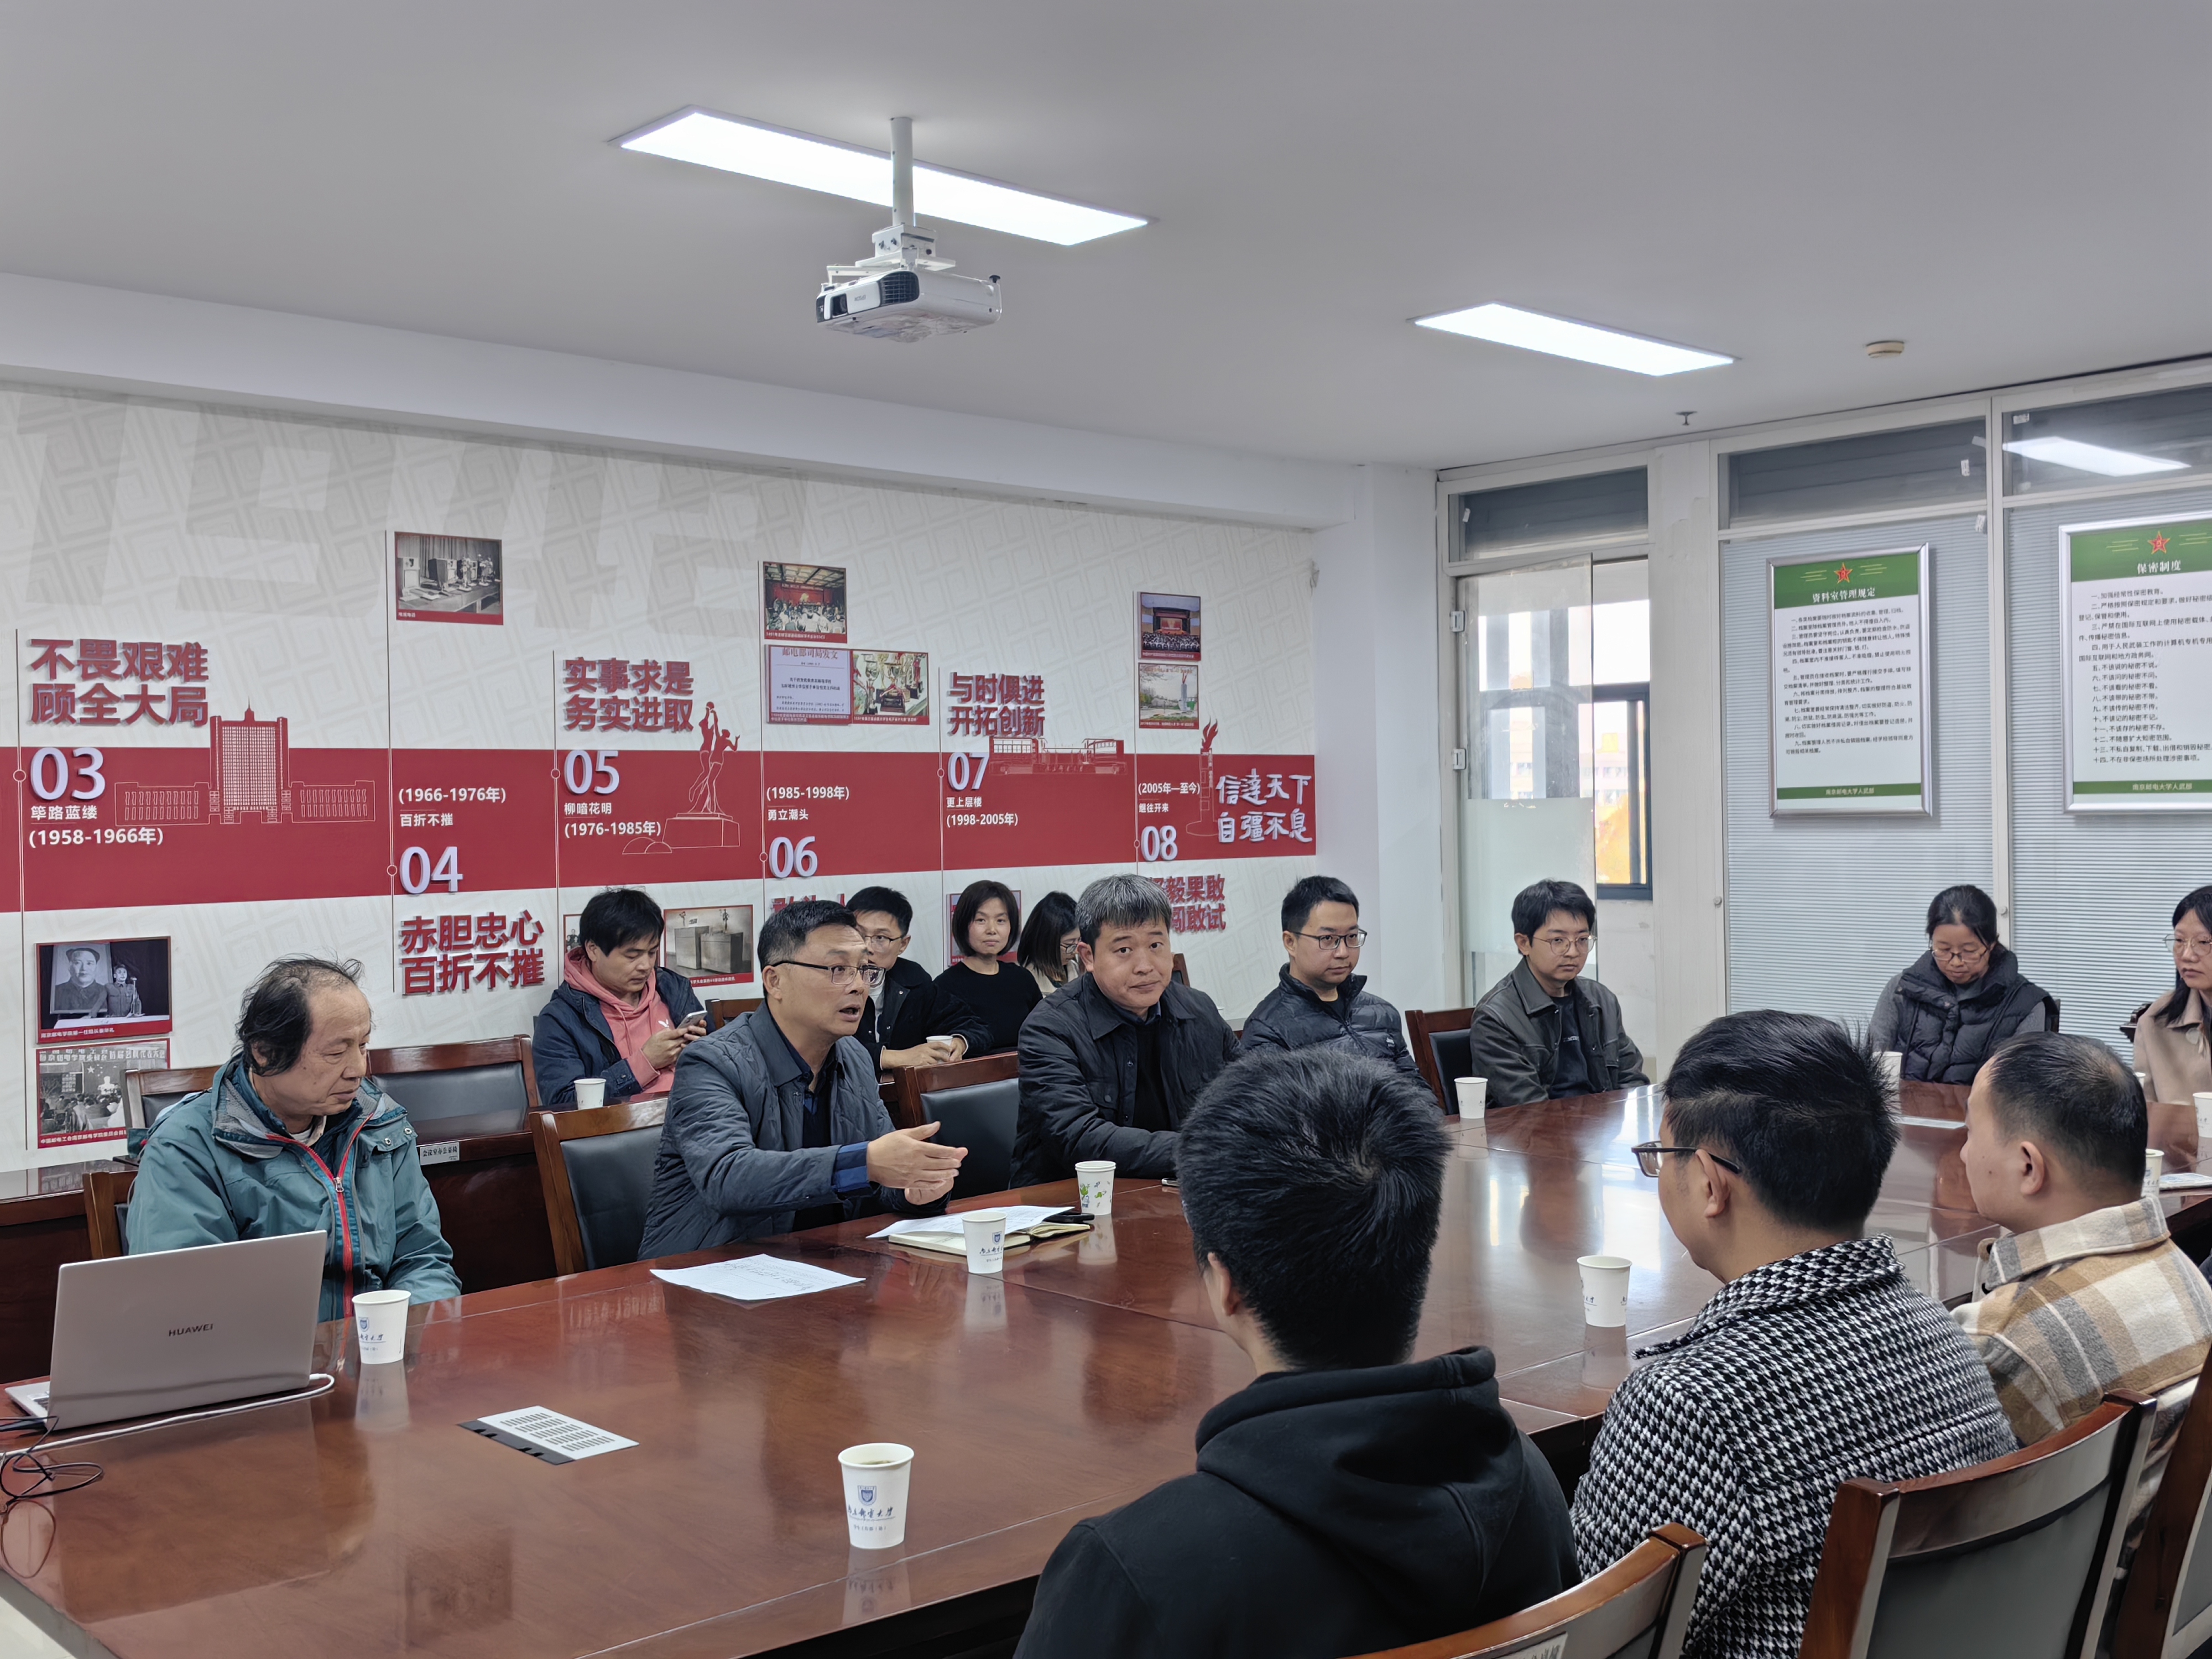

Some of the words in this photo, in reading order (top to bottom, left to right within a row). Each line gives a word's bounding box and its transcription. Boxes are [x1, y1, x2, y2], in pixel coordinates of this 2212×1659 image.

[2137, 559, 2182, 575] 保密制度
[1812, 587, 1876, 603] 资料室管理规定
[30, 638, 208, 682] 不畏艰难
[563, 657, 694, 695] 实事求是
[947, 672, 1045, 705] 与时俱进
[30, 683, 208, 728] 顾全大局
[563, 695, 694, 733] 务实进取
[947, 705, 1045, 737] 开拓创新
[30, 747, 106, 801] 03
[564, 749, 620, 794] 05
[947, 752, 990, 791] 07
[399, 787, 507, 805] (1966-1976年)
[564, 802, 612, 815] 柳暗花明
[766, 786, 850, 801] (1985-1998年)
[947, 796, 982, 808] 更上层楼
[1139, 803, 1169, 813] 继往开来
[565, 821, 661, 838] (1976-1985年)
[768, 808, 809, 821] 勇立潮头
[946, 812, 1019, 828] (1998-2005年)
[29, 827, 164, 848] (1958-1966年)
[1141, 825, 1178, 862] 08
[400, 846, 463, 895] 04
[769, 836, 818, 879] 06
[399, 910, 545, 954] 赤胆忠心
[399, 948, 545, 997] 百折不摧
[168, 1323, 214, 1337] HUAWEI
